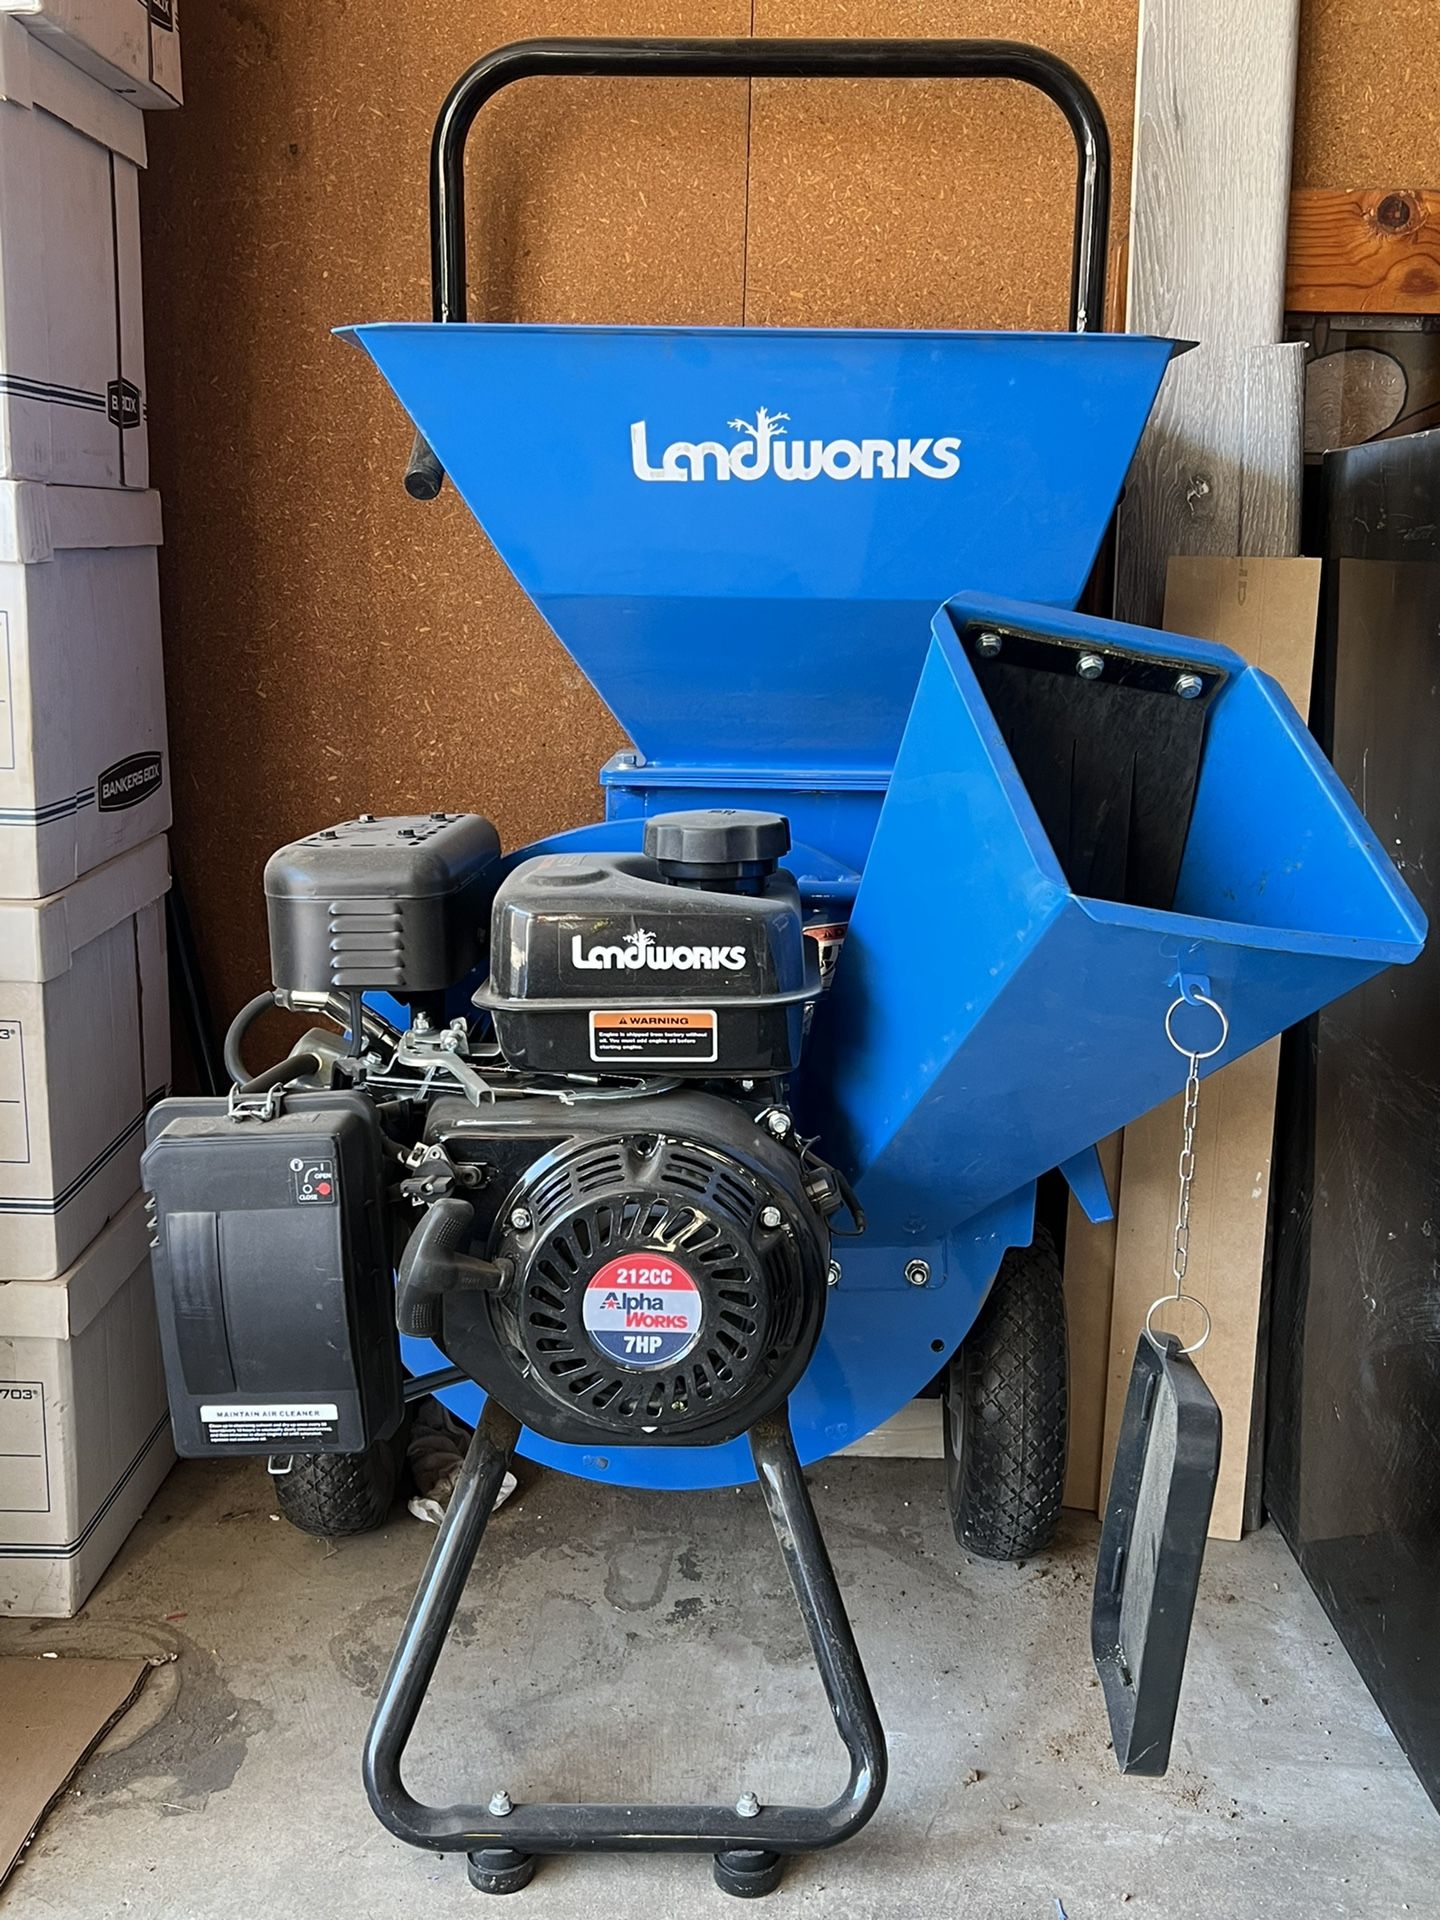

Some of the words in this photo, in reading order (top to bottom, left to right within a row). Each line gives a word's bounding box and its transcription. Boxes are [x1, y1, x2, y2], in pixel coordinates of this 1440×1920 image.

[103, 770, 143, 799] BANKERS
[144, 763, 160, 782] BOX
[629, 1017, 689, 1025] WARNING
[616, 1268, 673, 1285] 212CC
[600, 1291, 664, 1315] Alpha
[625, 1311, 688, 1329] WORKS
[623, 1335, 663, 1354] 7HP
